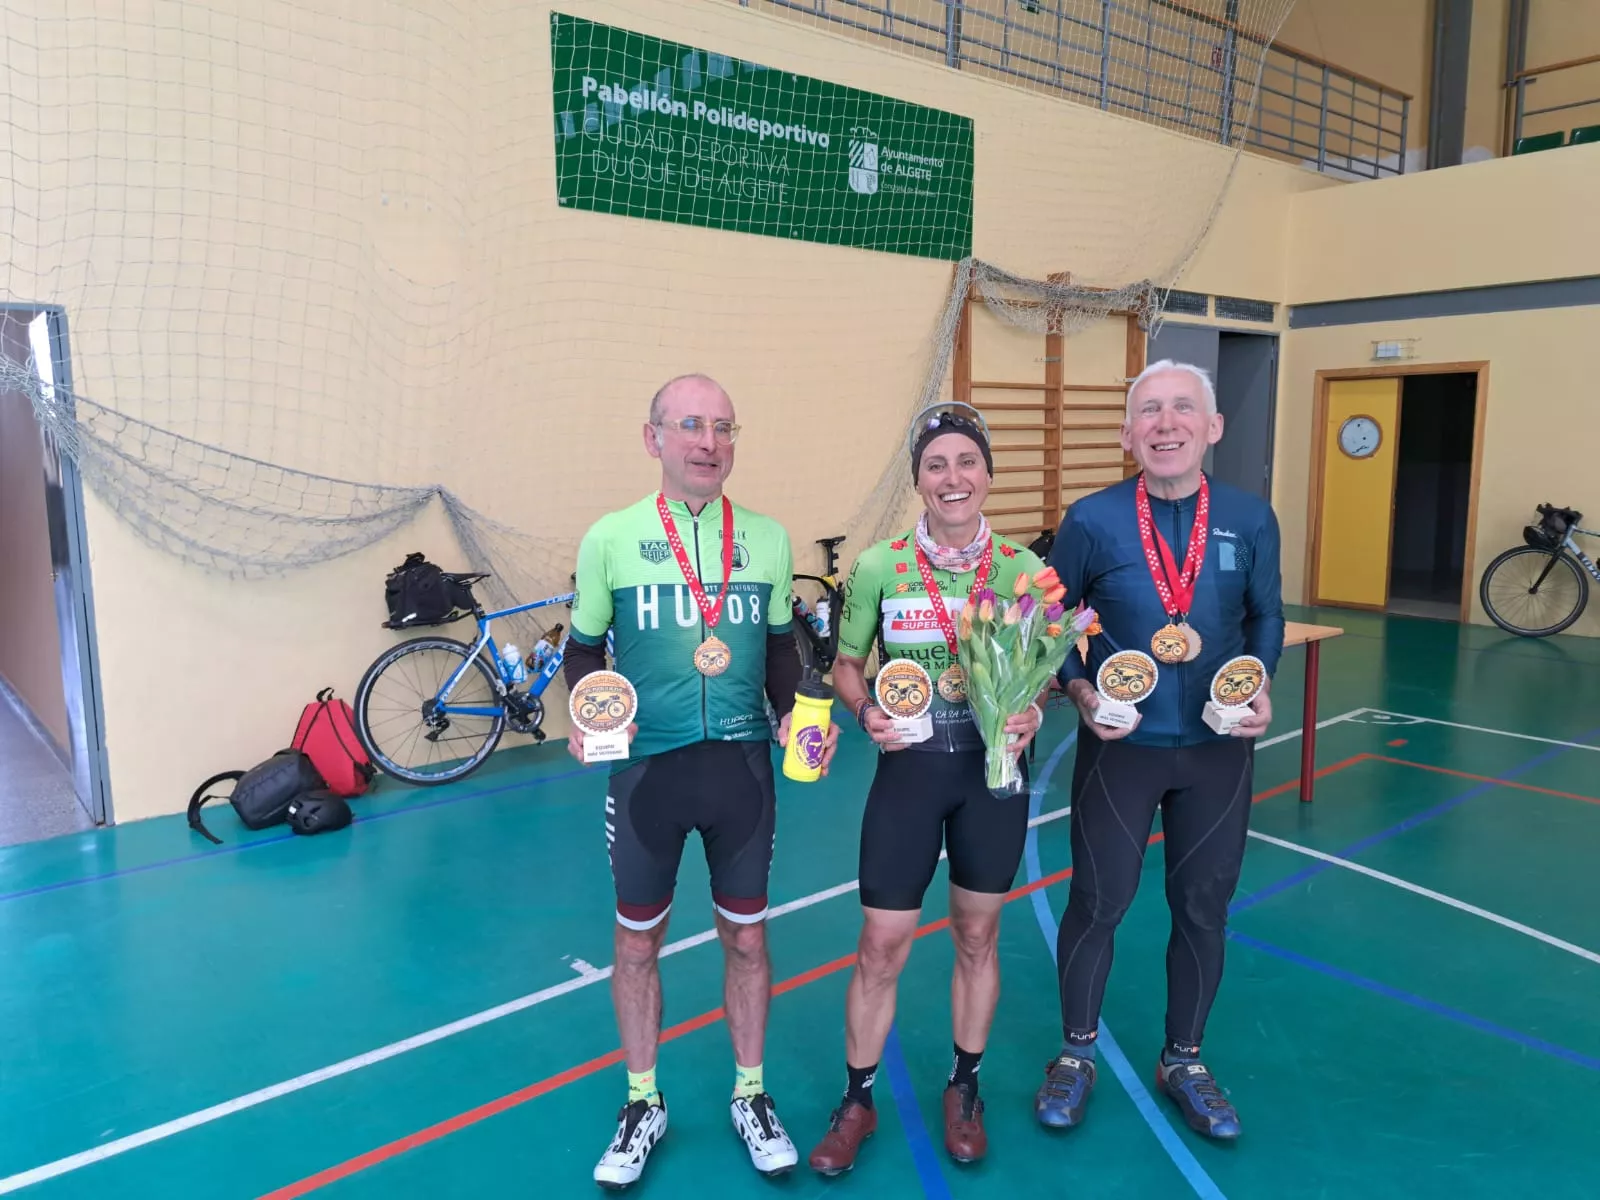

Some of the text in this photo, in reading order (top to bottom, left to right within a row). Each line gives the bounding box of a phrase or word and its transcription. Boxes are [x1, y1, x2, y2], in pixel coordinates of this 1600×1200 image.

[582, 75, 830, 148] Pabellón Polideportivo
[584, 117, 790, 177] CIUDAD DEPORTIVA
[881, 146, 944, 168] Ayuntamiento
[592, 149, 788, 204] DUQUE DE ALGETE
[881, 161, 932, 181] de ALGETE
[641, 542, 668, 550] TAG
